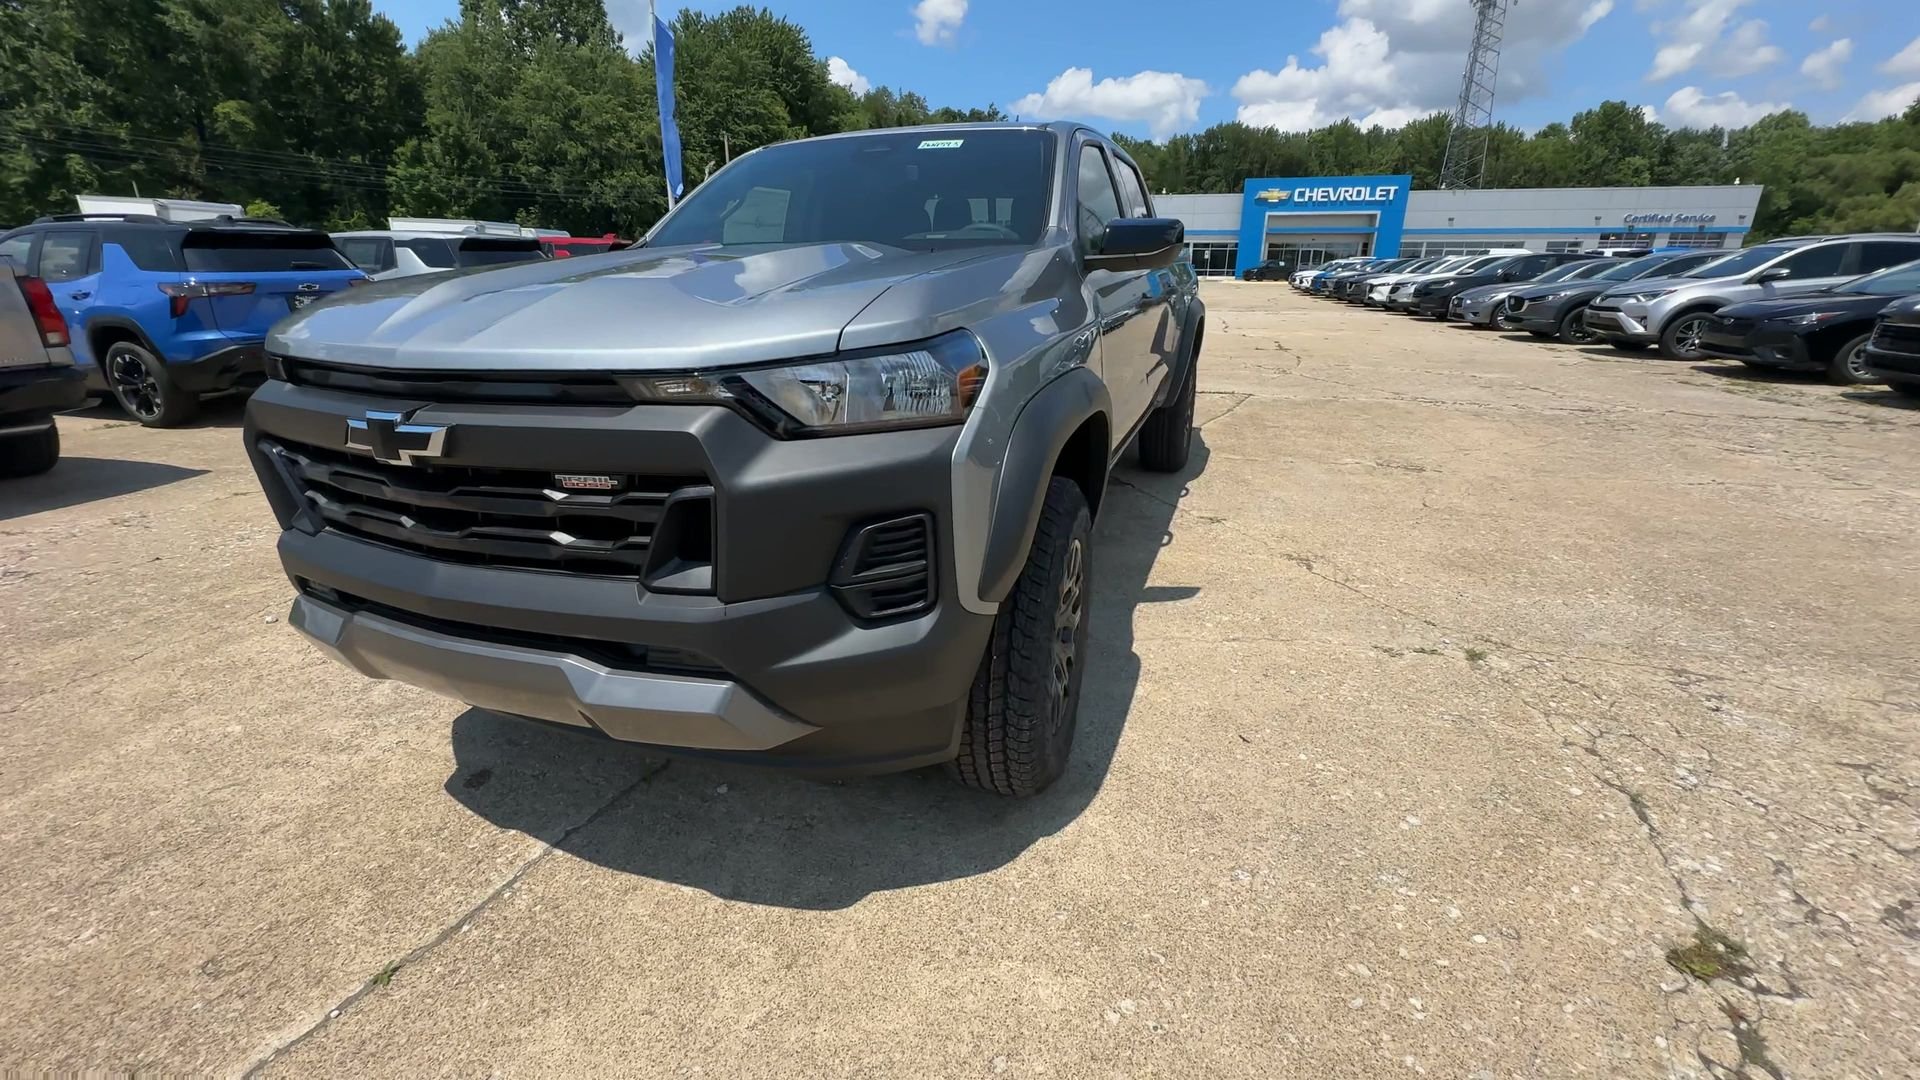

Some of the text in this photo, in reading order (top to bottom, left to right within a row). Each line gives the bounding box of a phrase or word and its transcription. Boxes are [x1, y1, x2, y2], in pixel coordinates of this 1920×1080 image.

[1294, 186, 1399, 202] CHEVROLET
[1623, 213, 1716, 224] Certified Service
